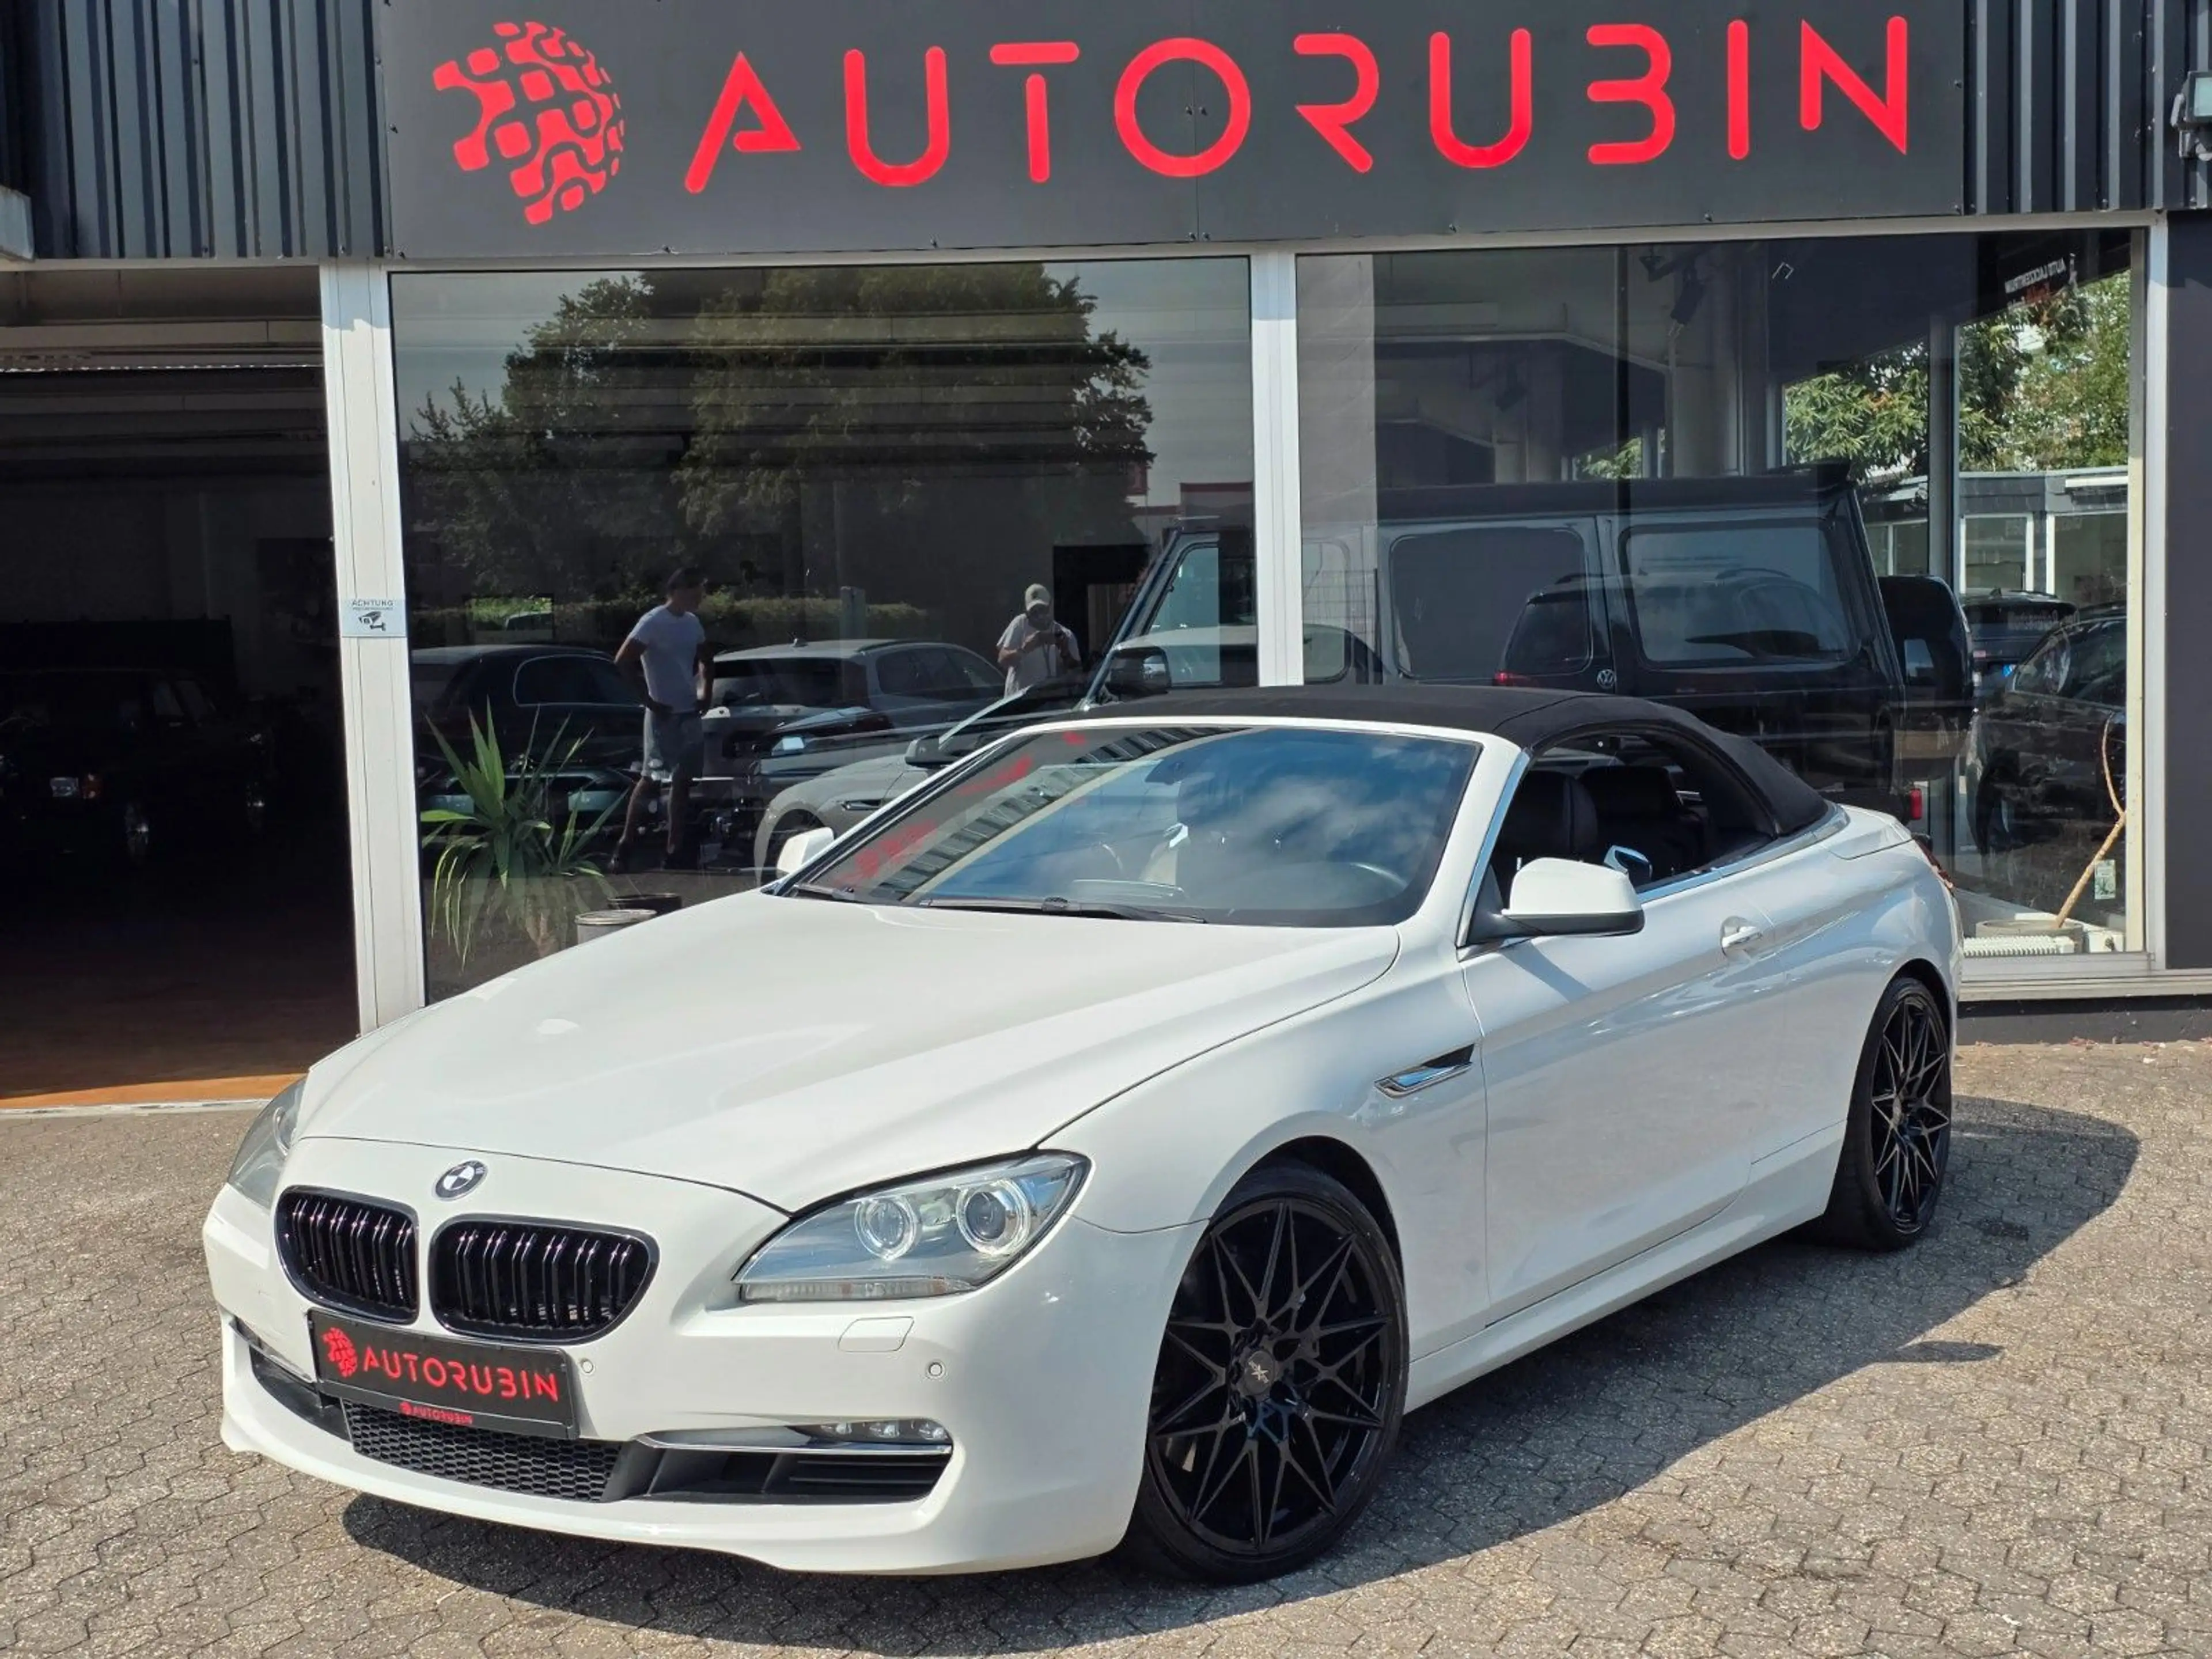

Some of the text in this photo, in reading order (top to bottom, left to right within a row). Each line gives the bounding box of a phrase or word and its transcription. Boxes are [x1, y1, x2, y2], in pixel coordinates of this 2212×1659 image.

[684, 16, 1908, 194] AUTORUBIN
[362, 1346, 559, 1402] AUTORUBIN
[412, 1405, 473, 1425] AUTORUBIN
